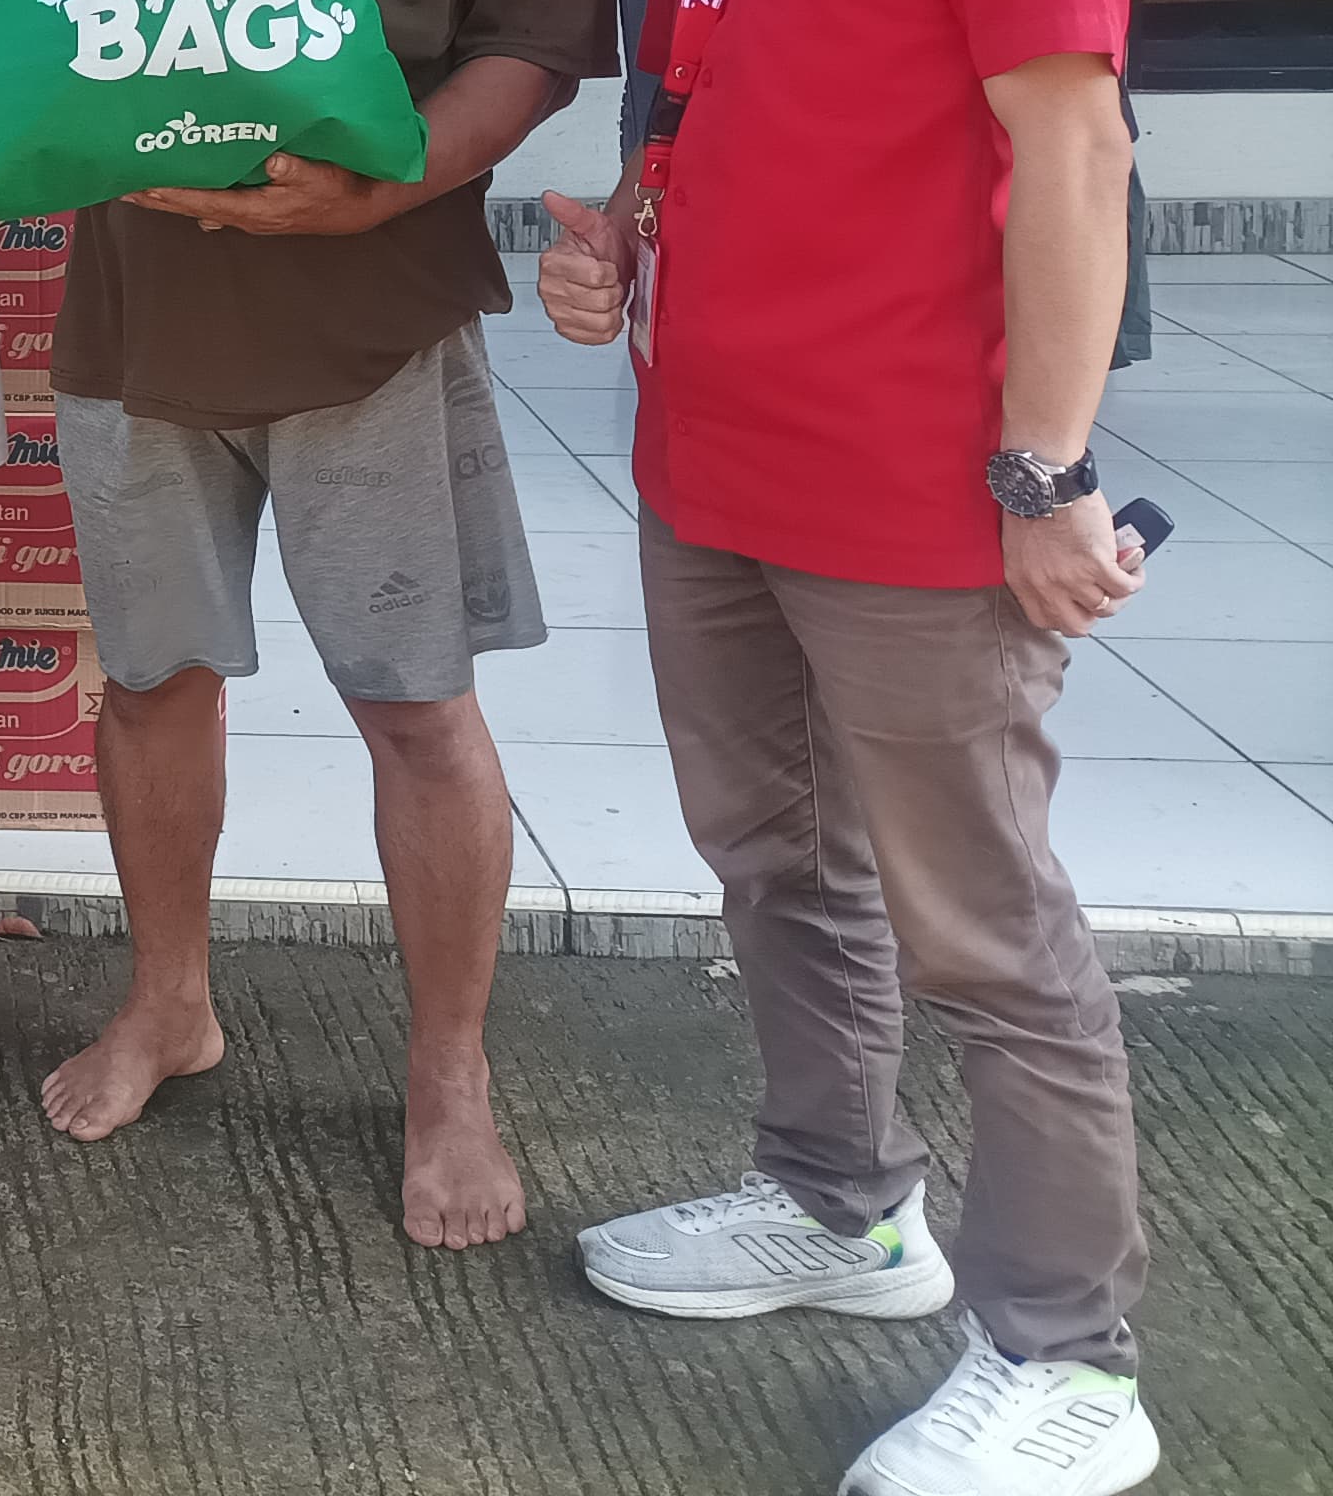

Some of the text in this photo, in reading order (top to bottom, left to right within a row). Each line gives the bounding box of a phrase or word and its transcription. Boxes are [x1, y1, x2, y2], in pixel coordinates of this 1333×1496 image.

[135, 122, 278, 153] GO GREEN
[7, 331, 53, 360] go
[13, 394, 31, 402] CBP
[315, 465, 394, 488] adidas
[11, 545, 78, 573] gor
[15, 607, 32, 616] CBP
[34, 608, 66, 616] SUKSES
[8, 812, 26, 820] CBP
[27, 812, 58, 820] SUKSES
[59, 812, 98, 820] MAKMUR
